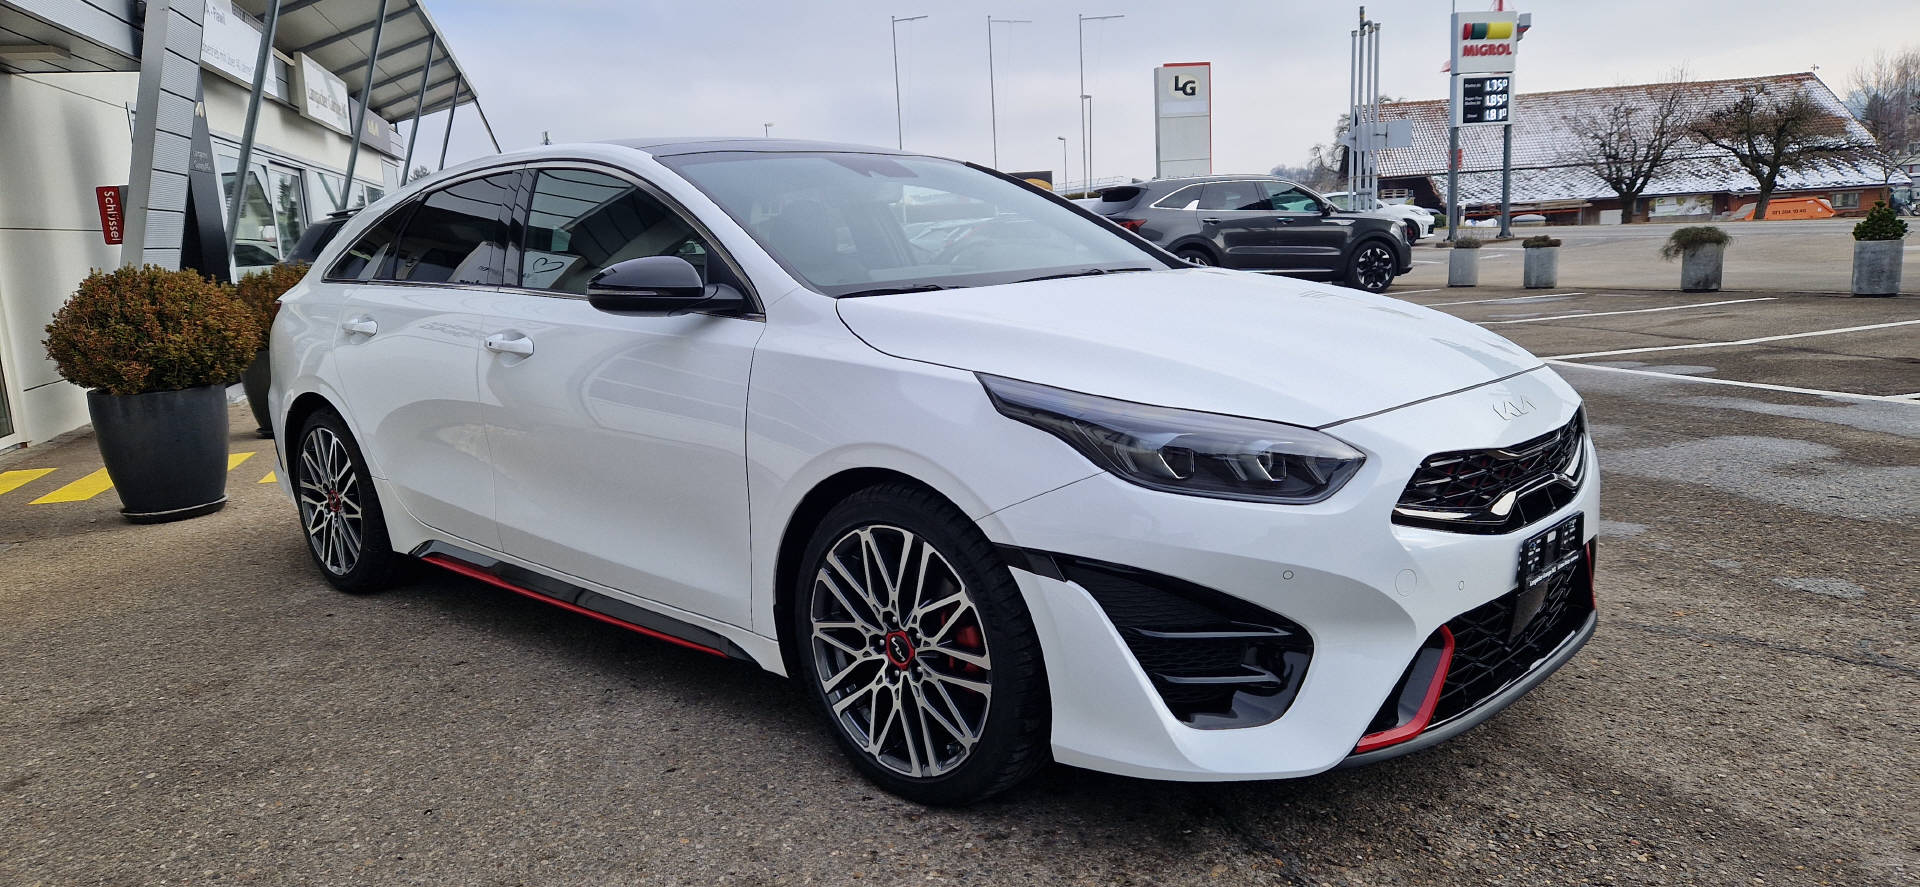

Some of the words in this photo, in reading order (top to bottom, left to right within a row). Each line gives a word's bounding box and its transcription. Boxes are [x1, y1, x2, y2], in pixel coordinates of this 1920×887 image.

[1463, 43, 1512, 57] MIGROL
[1174, 75, 1196, 96] LG
[104, 191, 122, 241] Schlüssel
